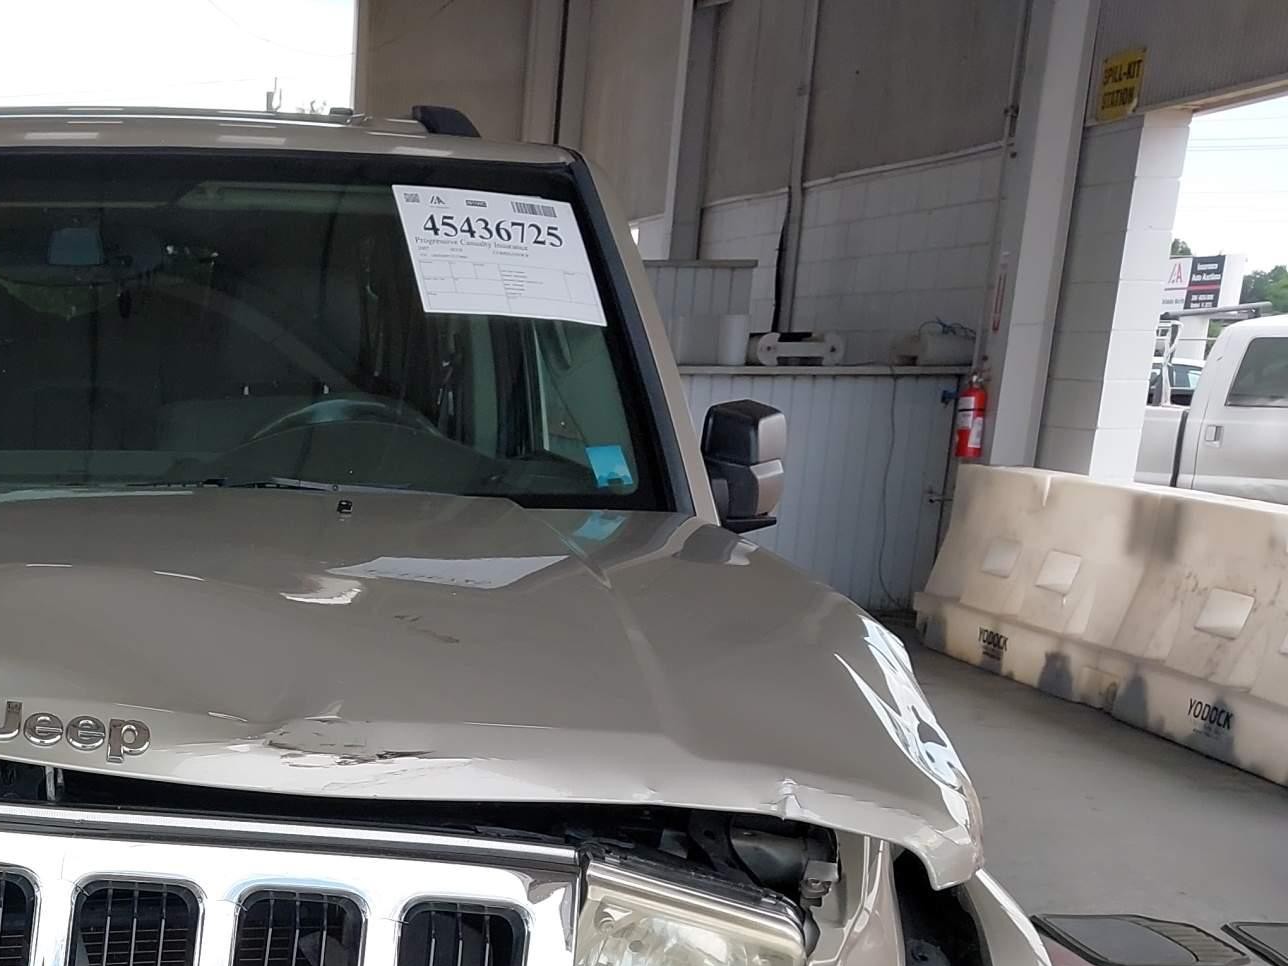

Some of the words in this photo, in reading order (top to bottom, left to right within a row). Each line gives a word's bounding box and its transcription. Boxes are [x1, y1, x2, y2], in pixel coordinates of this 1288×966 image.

[1103, 59, 1143, 86] SPILL-KIT
[423, 214, 564, 248] 45436725
[978, 626, 1008, 652] YODOCK
[1187, 698, 1234, 731] YODOCK
